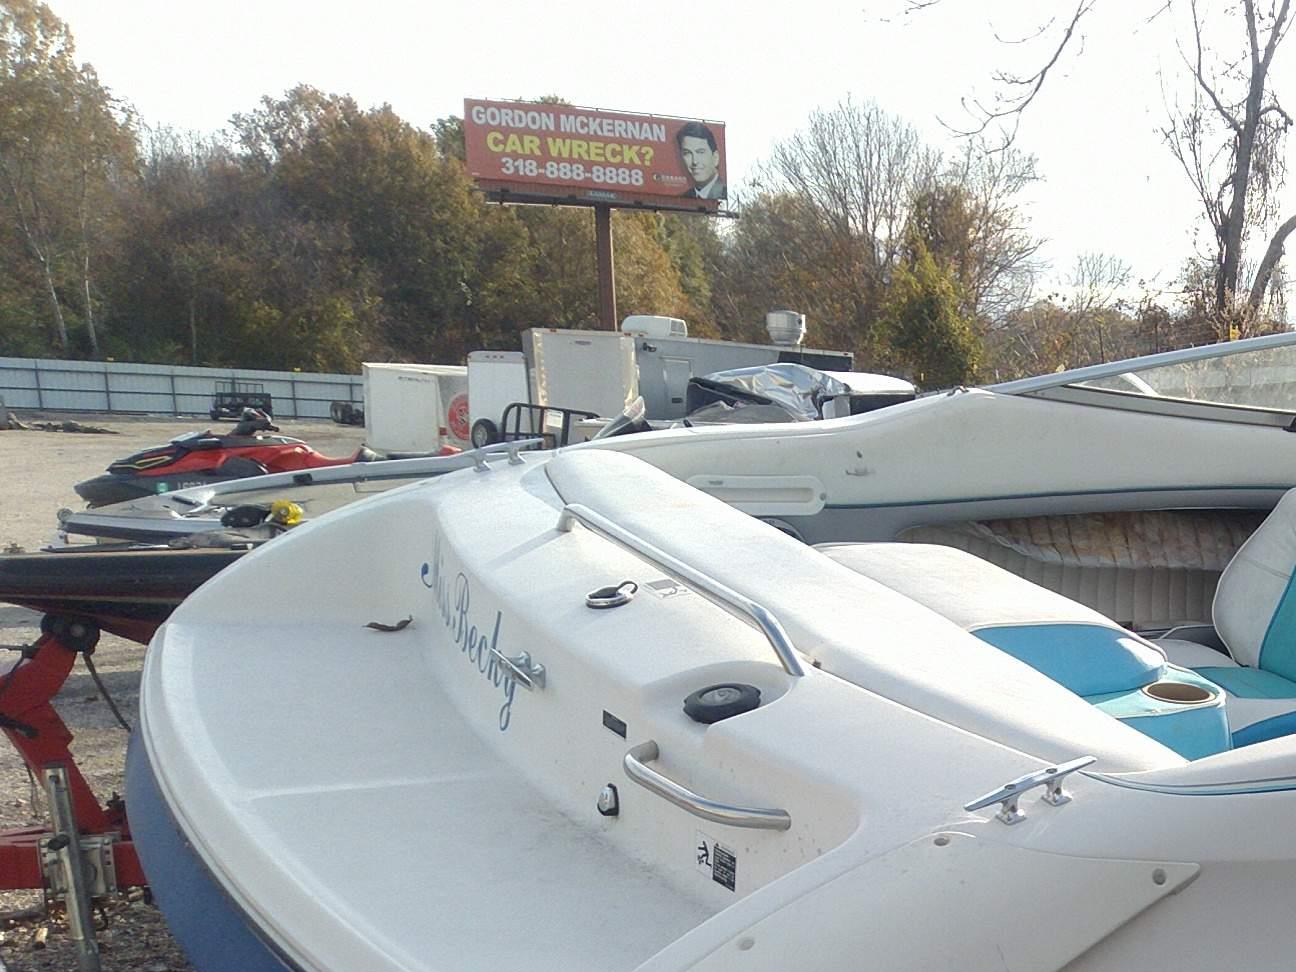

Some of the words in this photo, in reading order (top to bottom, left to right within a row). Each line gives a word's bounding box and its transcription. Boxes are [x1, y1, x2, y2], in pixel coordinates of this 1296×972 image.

[471, 106, 555, 131] GORDON
[560, 114, 666, 142] MCKERNAN
[486, 130, 543, 156] CAR
[547, 136, 654, 166] WRECK?
[500, 156, 644, 186] 318-888-8888
